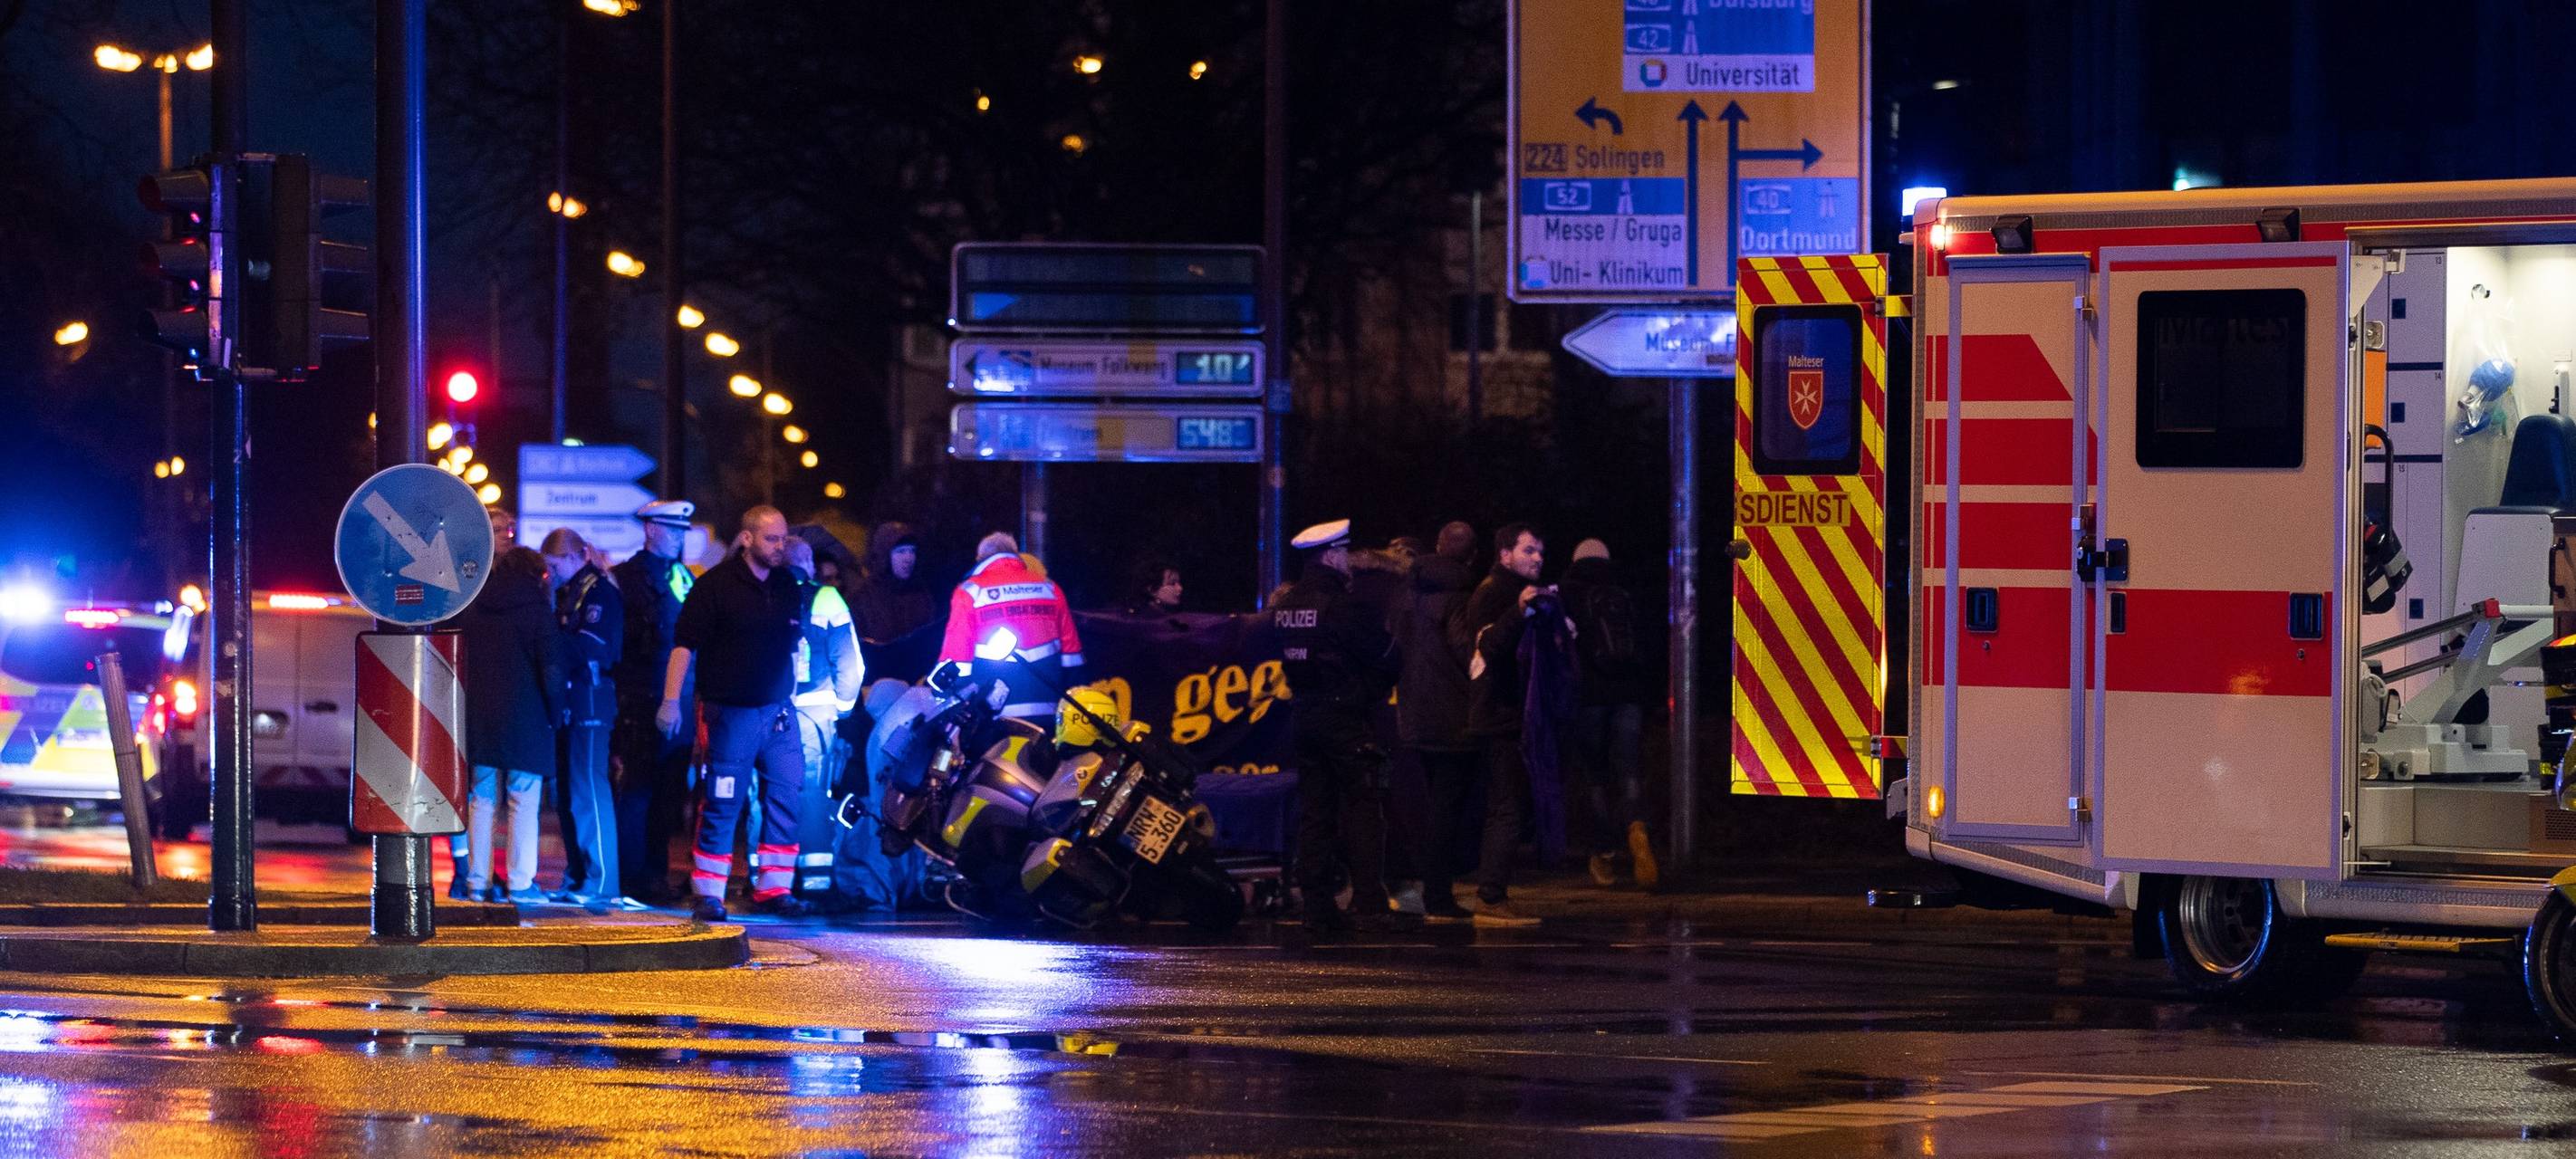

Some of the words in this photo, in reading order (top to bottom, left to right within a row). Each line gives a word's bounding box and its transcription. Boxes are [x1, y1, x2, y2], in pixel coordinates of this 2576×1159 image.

[1638, 30, 1659, 48] 42
[1687, 62, 1800, 86] Universität
[1527, 146, 1565, 169] 224
[1576, 145, 1665, 174] Solingen
[1557, 188, 1578, 205] 52
[1544, 218, 1604, 241] Messe
[1626, 217, 1682, 247] Gruga
[1741, 227, 1857, 251] Dortmund
[1598, 261, 1684, 284] Klinikum
[1788, 355, 1824, 368] Malteser
[1735, 493, 1849, 524] SDIENST
[1275, 609, 1318, 627] POLIZEI
[1127, 807, 1158, 842] NRW
